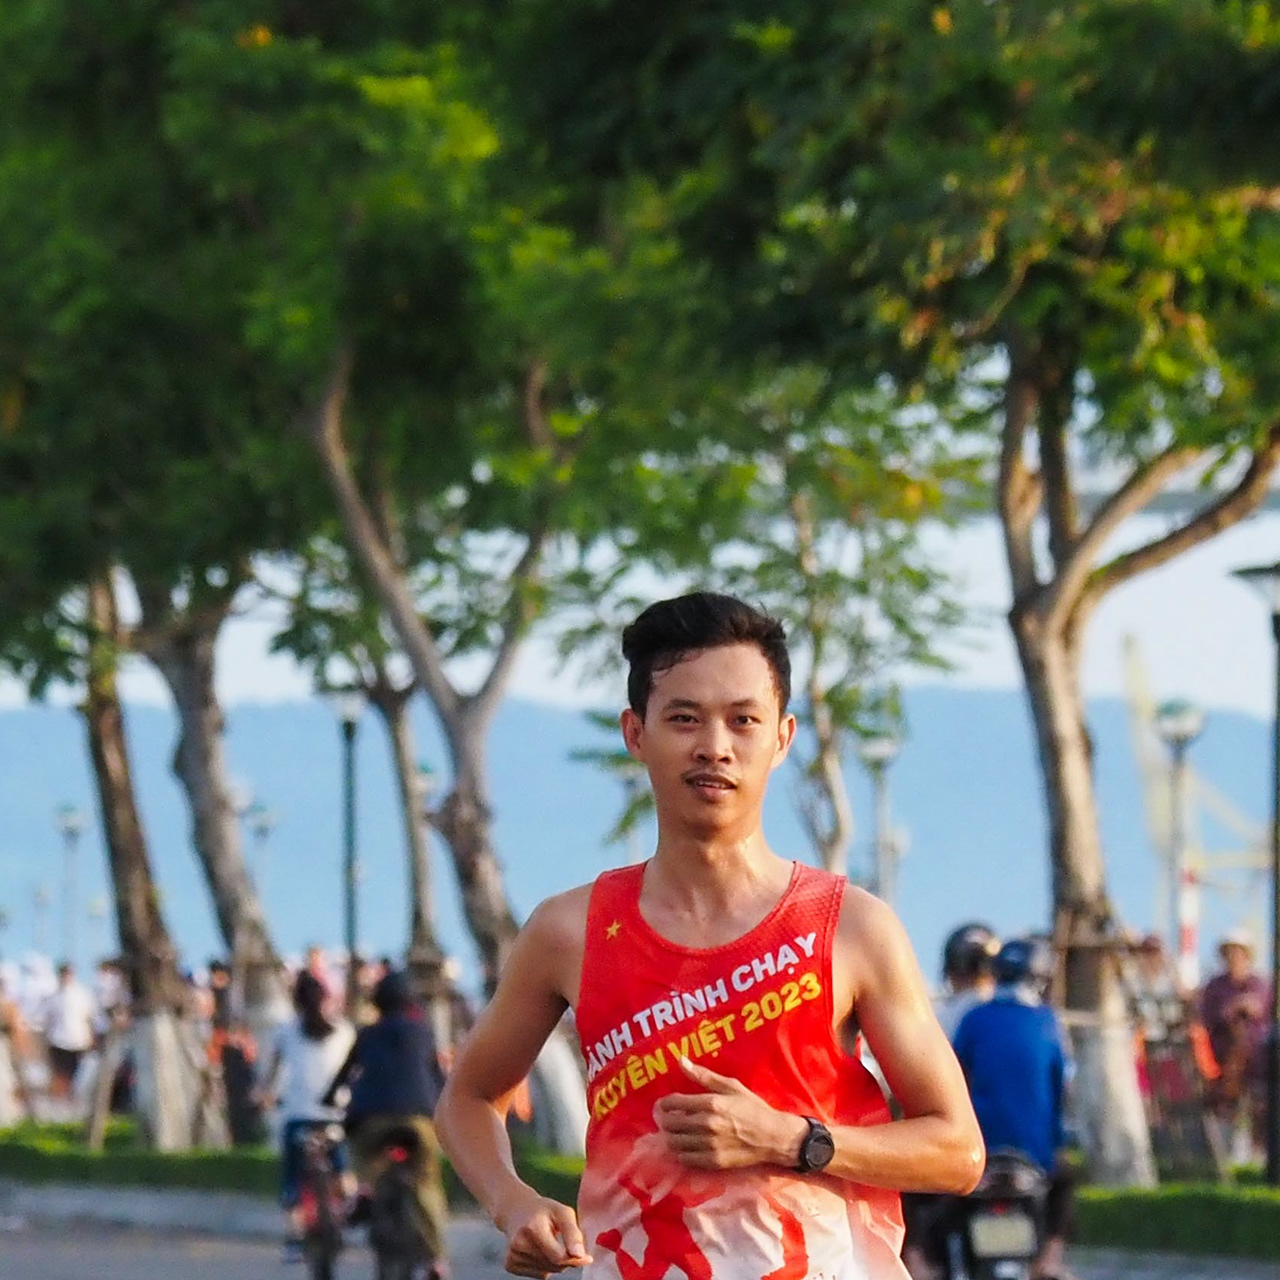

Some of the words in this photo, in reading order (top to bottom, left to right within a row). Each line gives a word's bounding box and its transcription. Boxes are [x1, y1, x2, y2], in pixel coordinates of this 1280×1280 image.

[632, 978, 729, 1039] TRÌNH
[731, 932, 817, 993] CHẠY
[667, 1014, 736, 1060] VIỆT
[741, 972, 821, 1033] 2023
